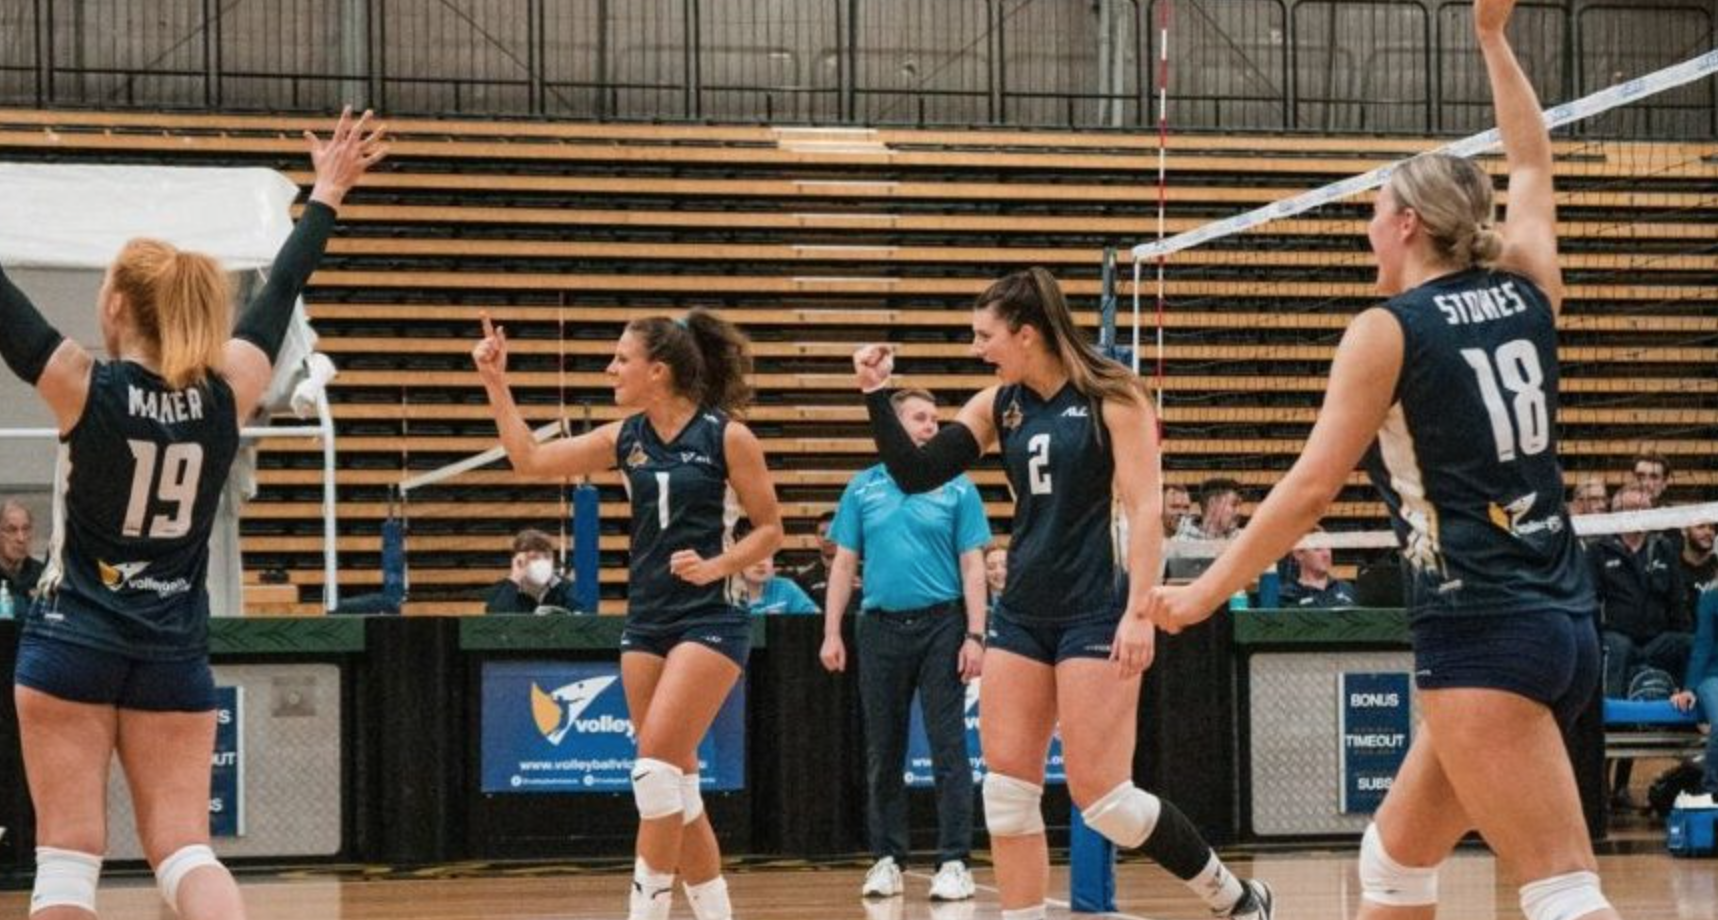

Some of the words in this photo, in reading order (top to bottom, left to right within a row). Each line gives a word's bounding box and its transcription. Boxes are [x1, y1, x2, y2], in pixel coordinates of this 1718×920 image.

[1433, 281, 1527, 325] STOKES
[128, 384, 204, 424] MAKER
[1459, 338, 1549, 462] 18
[1028, 433, 1052, 495] 2
[122, 439, 204, 539] 19
[655, 471, 670, 530] 1
[1350, 693, 1399, 708] BONUS
[1345, 733, 1405, 748] TIMEOUT
[1358, 777, 1393, 791] SUBS
